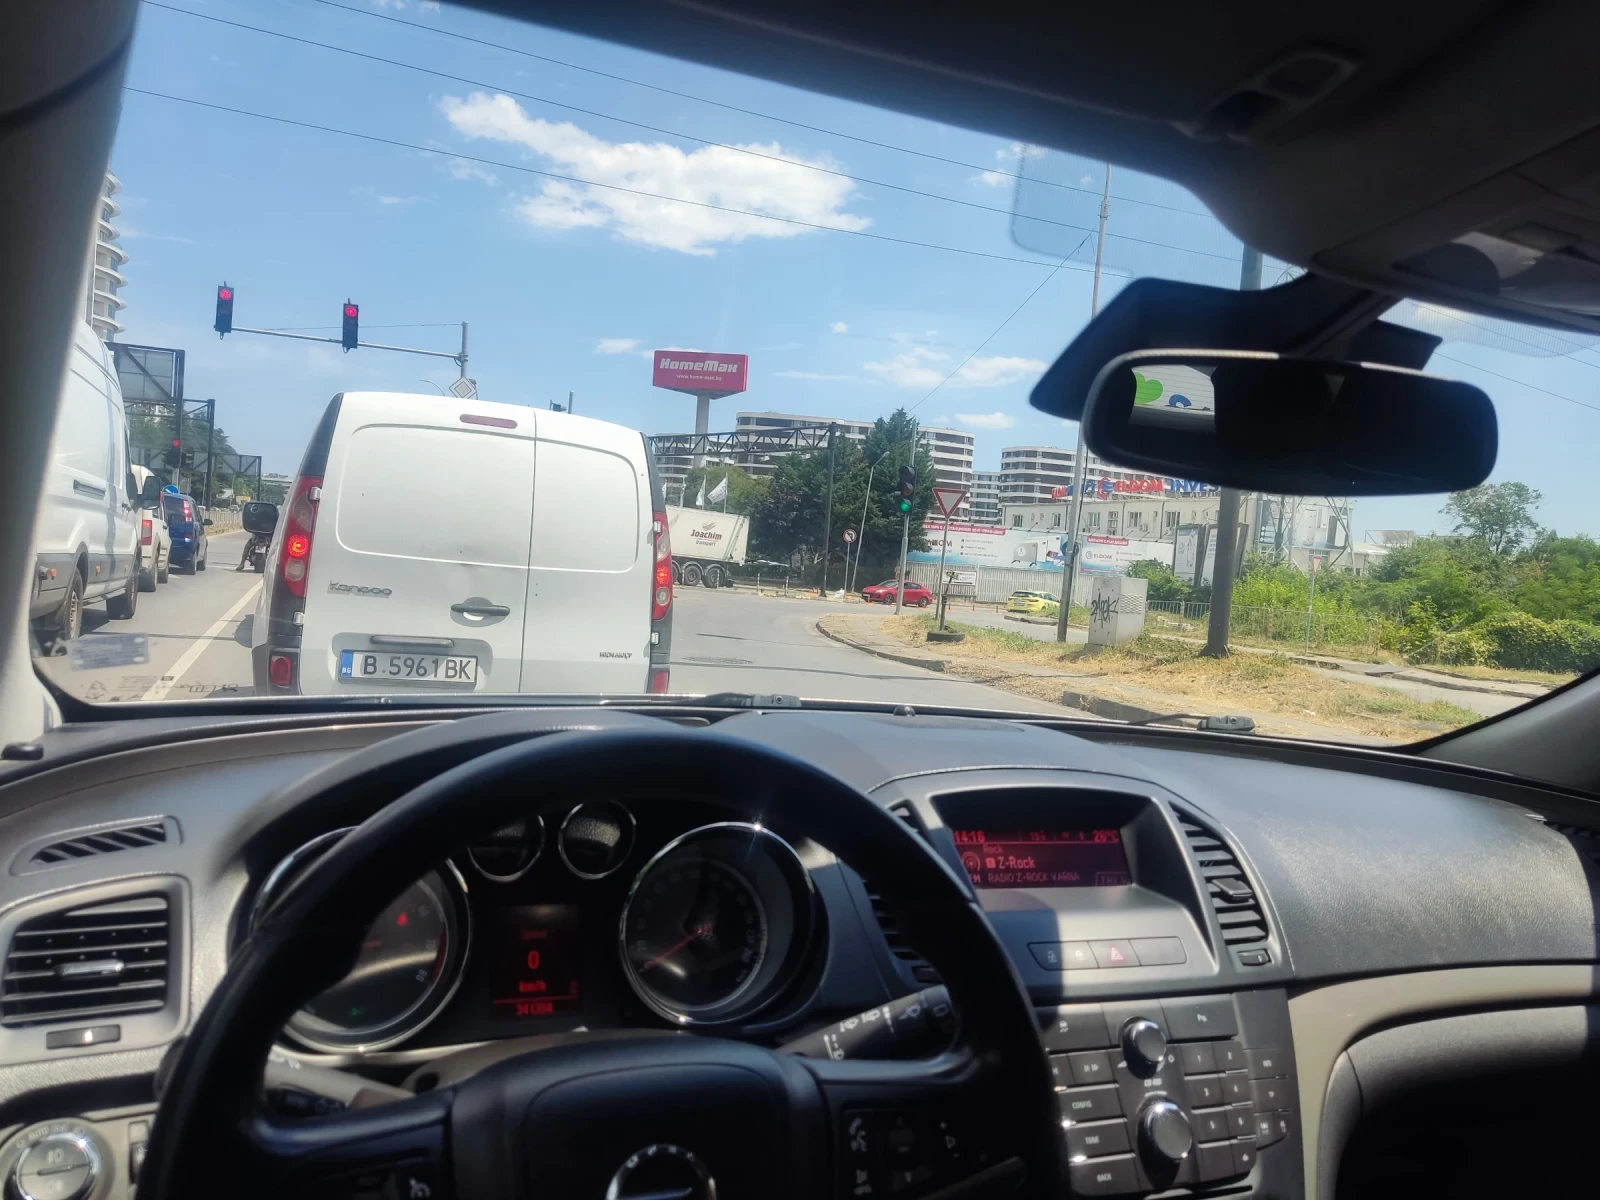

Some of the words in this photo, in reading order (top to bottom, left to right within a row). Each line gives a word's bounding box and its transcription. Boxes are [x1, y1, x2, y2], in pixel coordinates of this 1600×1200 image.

[660, 358, 738, 373] HomeMax
[676, 374, 722, 382] www.home-max.bg
[1171, 479, 1219, 493] INVES
[691, 529, 722, 541] Joachim
[695, 539, 716, 547] transport
[341, 666, 352, 674] BG
[998, 856, 1036, 870] Z-Rock
[988, 872, 1014, 884] RADIO
[1016, 872, 1048, 883] Z-ROCK
[1051, 870, 1080, 882] VARNA
[527, 950, 540, 970] 0
[1072, 1100, 1092, 1110] CONFIG
[1084, 1135, 1099, 1145] TONE
[1096, 1173, 1112, 1182] BACK
